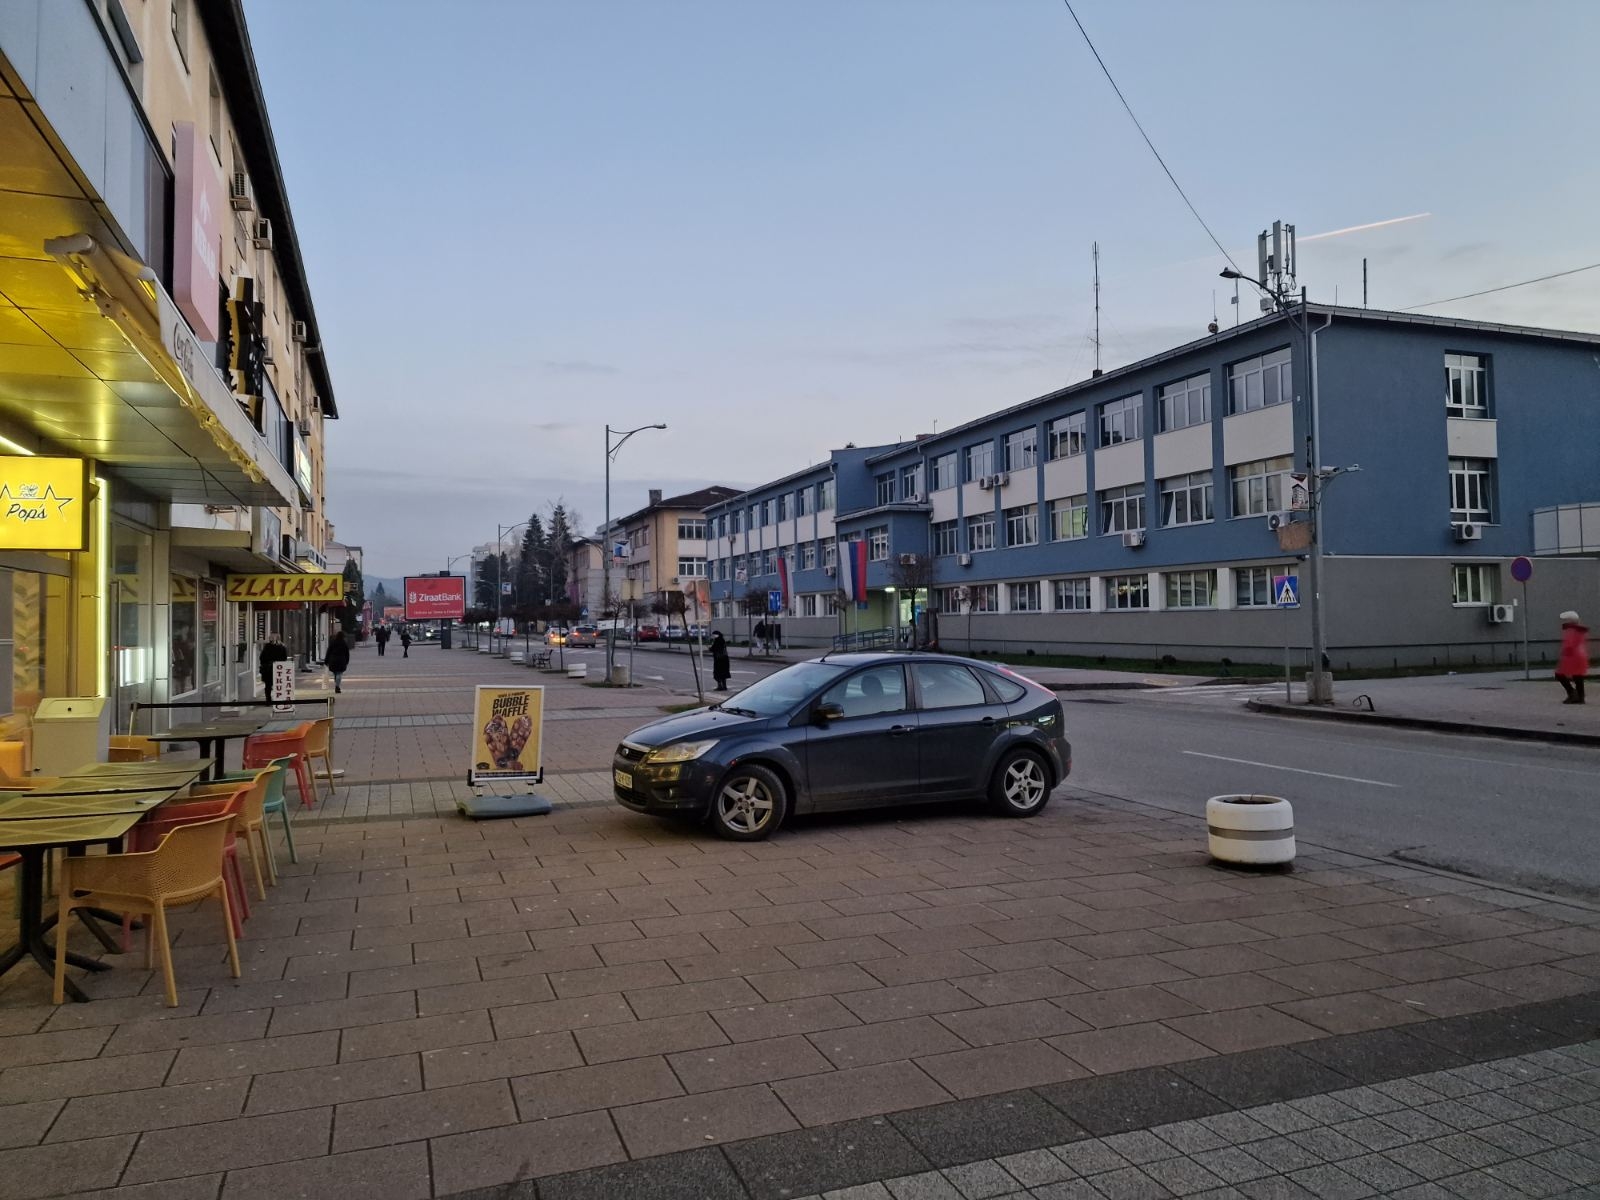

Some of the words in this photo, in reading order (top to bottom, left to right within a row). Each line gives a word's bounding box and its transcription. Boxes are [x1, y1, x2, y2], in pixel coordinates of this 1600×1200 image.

[229, 577, 340, 597] ZLATARA
[492, 694, 531, 710] BUBBLE
[492, 704, 529, 718] WAFFLE
